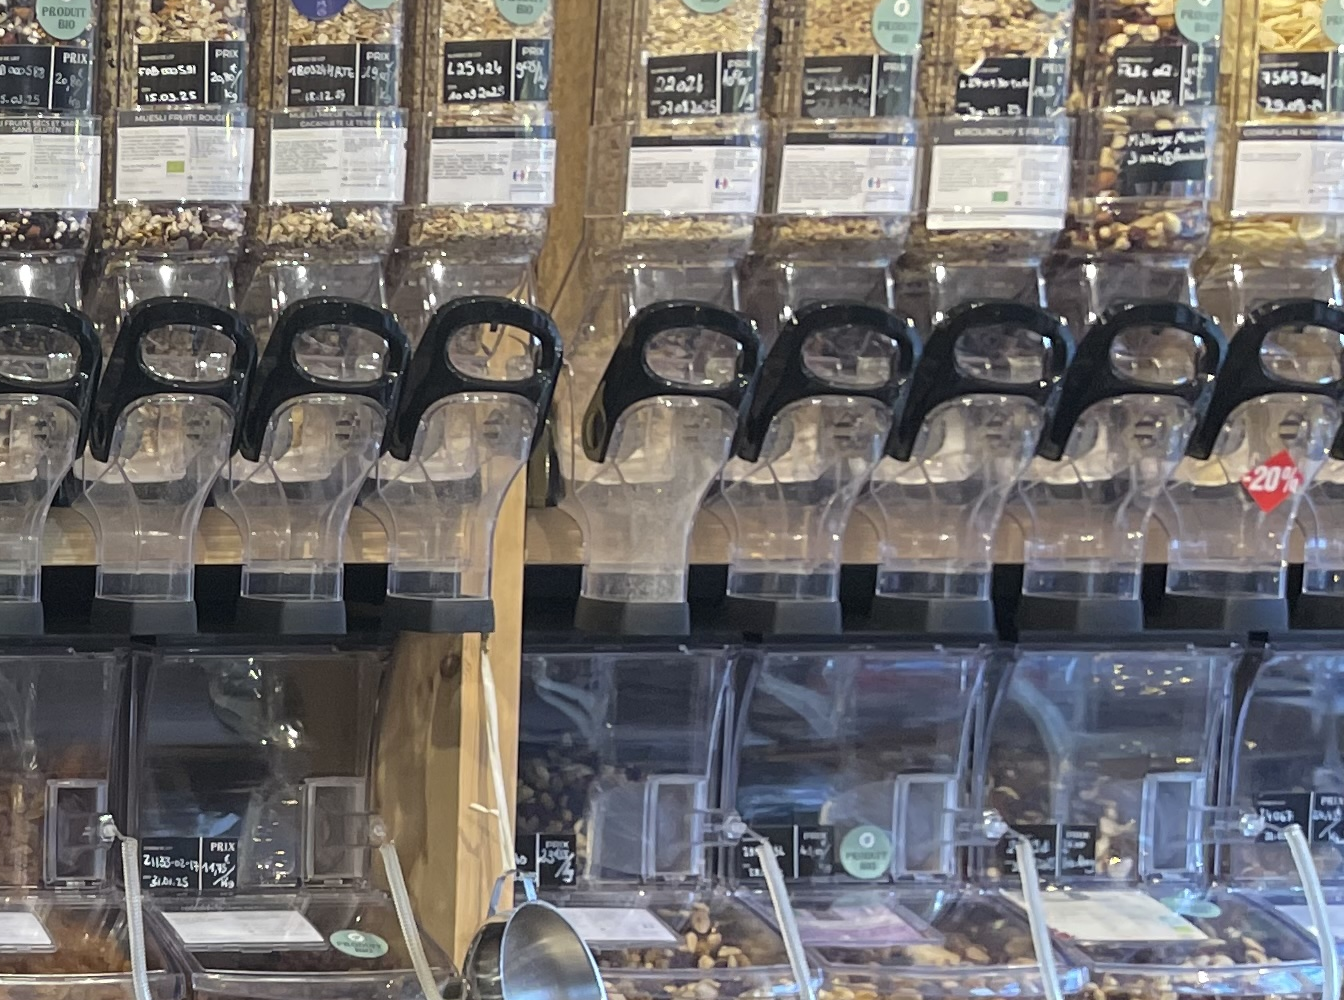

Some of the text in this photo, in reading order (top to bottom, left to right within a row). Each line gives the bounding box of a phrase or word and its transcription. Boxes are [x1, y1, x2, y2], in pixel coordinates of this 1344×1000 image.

[41, 7, 87, 18] PRODUIT
[57, 19, 76, 31] BIO
[215, 49, 238, 58] PRIX
[366, 52, 390, 61] PRIX
[522, 47, 544, 56] PRIX
[63, 53, 87, 64] PRIX
[135, 114, 167, 122] MUESLI
[1242, 465, 1301, 494] -20%
[210, 842, 235, 852] PRIX
